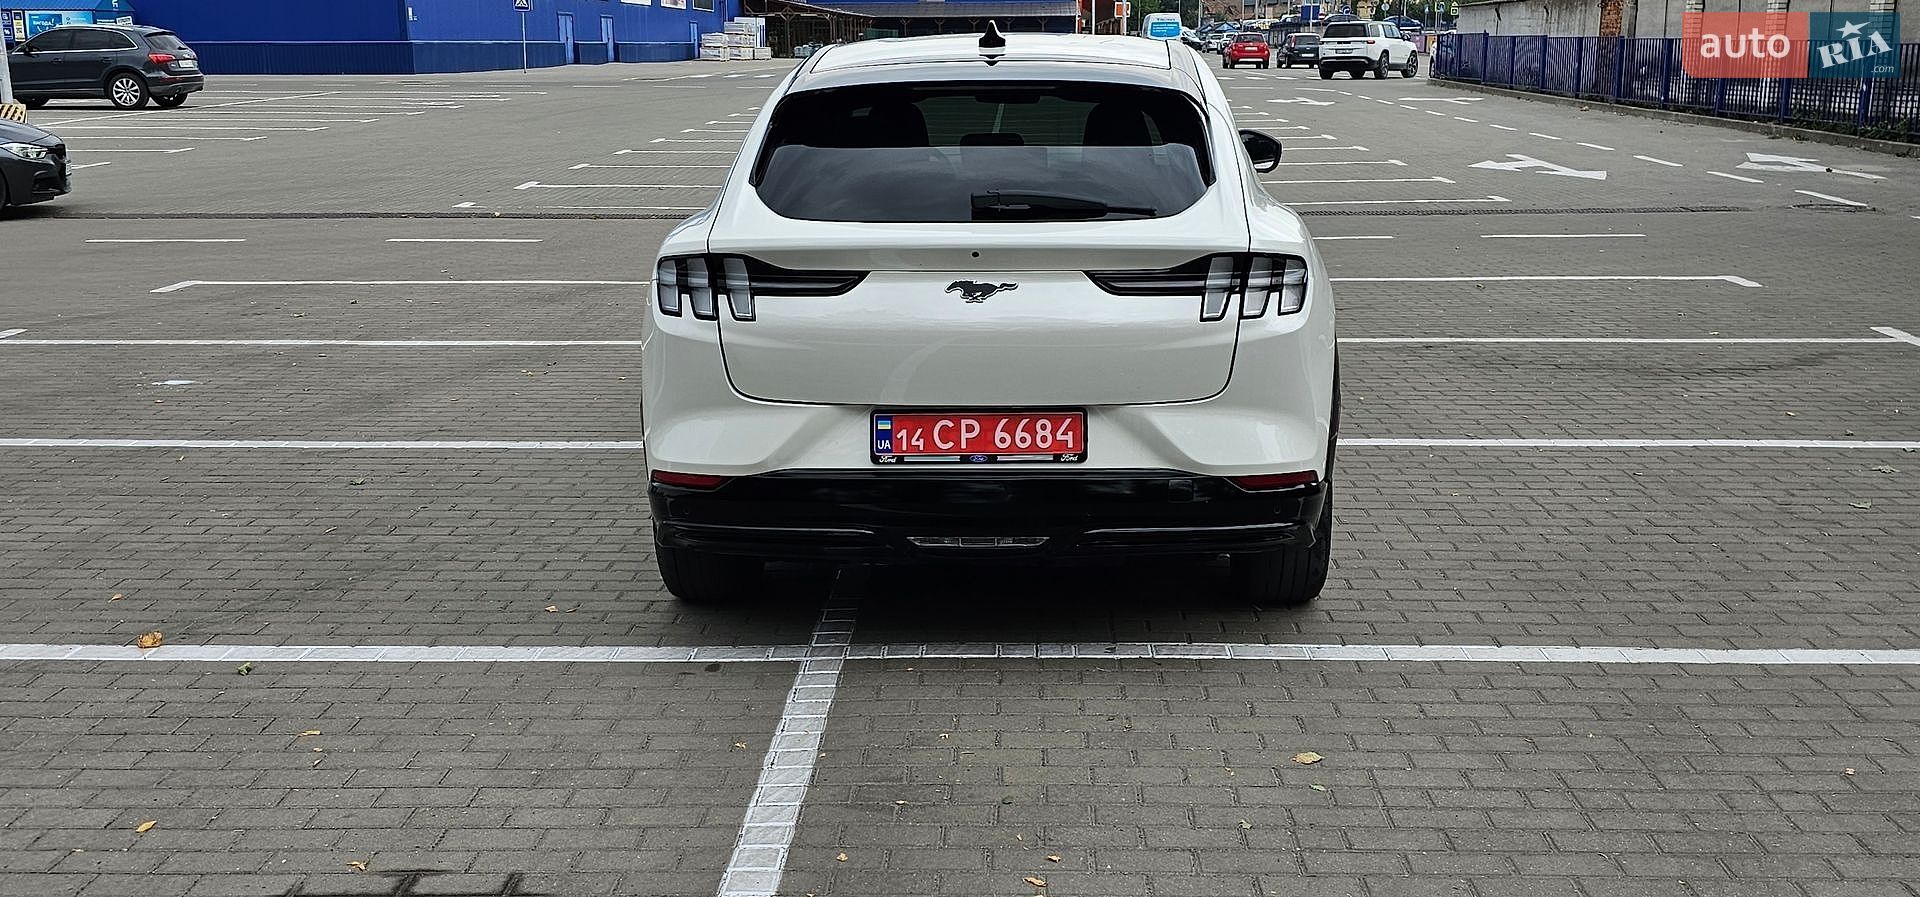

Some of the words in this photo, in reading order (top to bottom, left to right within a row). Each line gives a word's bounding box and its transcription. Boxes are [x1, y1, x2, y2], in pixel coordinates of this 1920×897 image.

[896, 428, 924, 451] 14
[933, 419, 980, 449] CP
[994, 418, 1074, 449] 6684
[877, 440, 891, 450] UA
[879, 454, 897, 463] Ford
[1060, 454, 1078, 462] Ford
